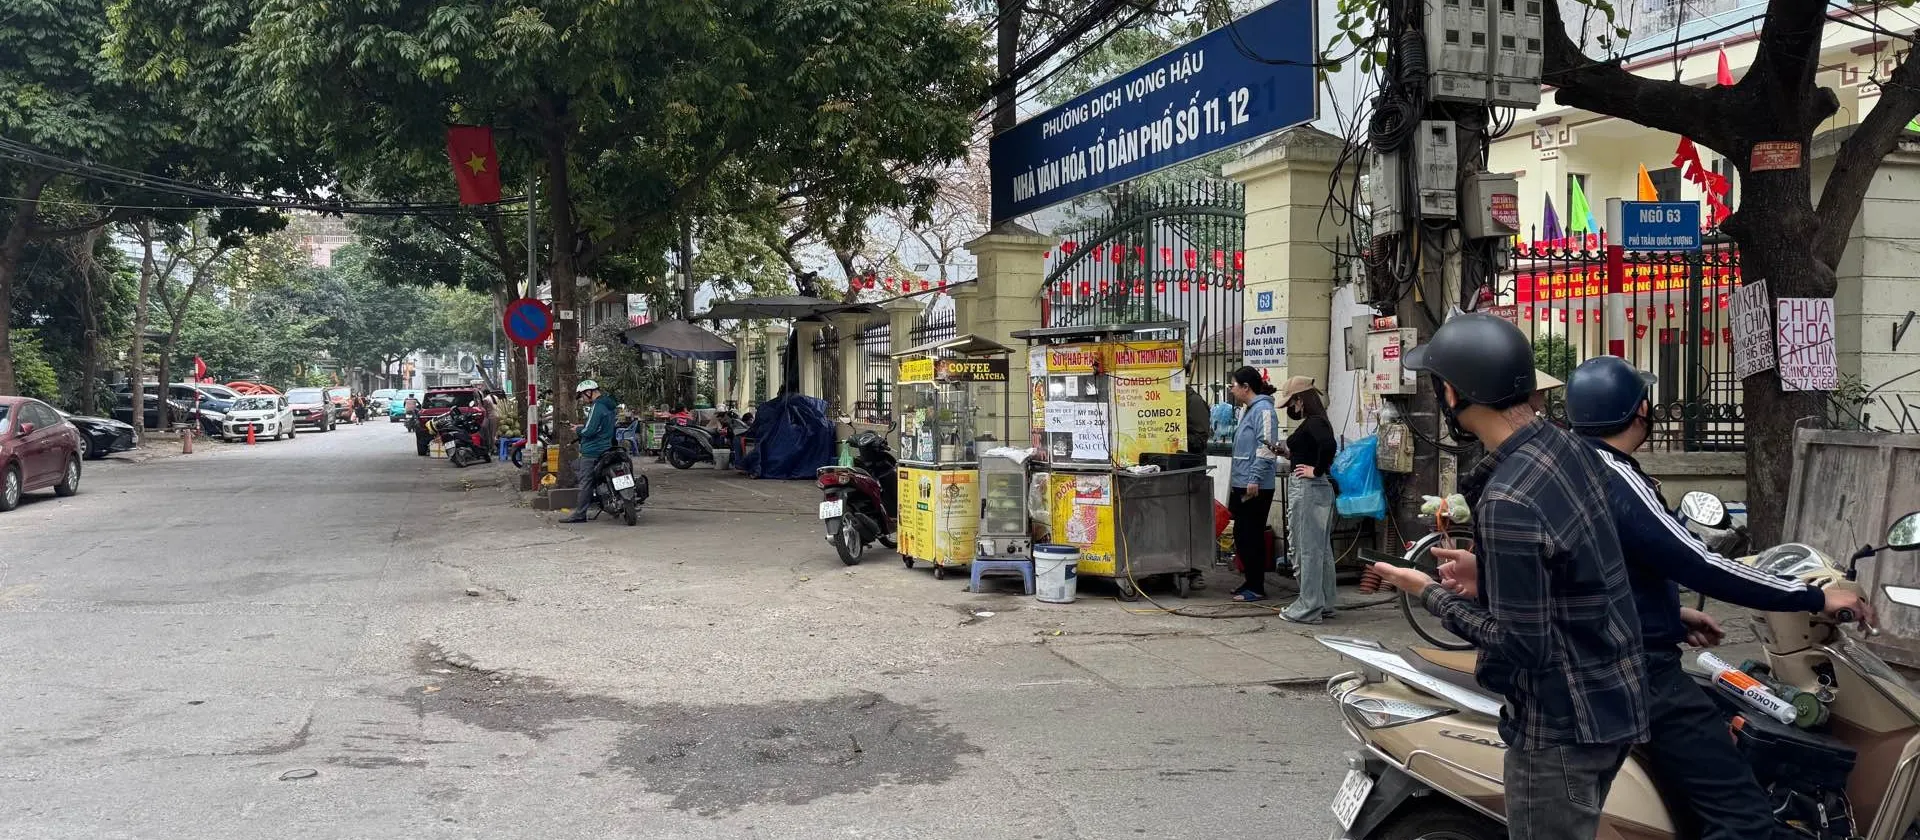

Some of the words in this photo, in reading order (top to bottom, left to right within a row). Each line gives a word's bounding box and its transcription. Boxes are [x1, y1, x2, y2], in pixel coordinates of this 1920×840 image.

[1042, 107, 1089, 140] PHƯỜNG
[1091, 88, 1122, 119] DỊCH
[1125, 69, 1166, 103] VỌNG
[1170, 49, 1205, 85] HẬU
[1013, 165, 1035, 204] NHÀ
[1036, 158, 1060, 194] VĂN
[1061, 145, 1088, 185] HÓA
[1088, 127, 1105, 176] TỔ
[1108, 129, 1140, 170] DÂN
[1140, 102, 1174, 158] PHỐ
[1176, 91, 1201, 145] SỐ
[1203, 97, 1226, 136] 11,
[1228, 87, 1250, 126] 12
[1640, 206, 1664, 223] NGÕ
[1666, 208, 1681, 223] 63
[1628, 231, 1640, 246] PHỐ
[1641, 231, 1656, 246] TRẦN
[1656, 231, 1672, 247] QUỐC
[1673, 235, 1693, 247] VƯỢNG
[1260, 294, 1271, 309] 63
[1254, 323, 1276, 335] CẤM
[1158, 350, 1178, 363] NGON
[1276, 347, 1286, 355] XE
[948, 363, 990, 373] COFFEE
[1116, 376, 1152, 387] COMBO
[1144, 390, 1161, 401] 30k
[1137, 408, 1173, 418] COMBO
[1175, 408, 1182, 417] 2
[1164, 422, 1181, 433] 25k
[1746, 690, 1781, 711] ALOKEO
